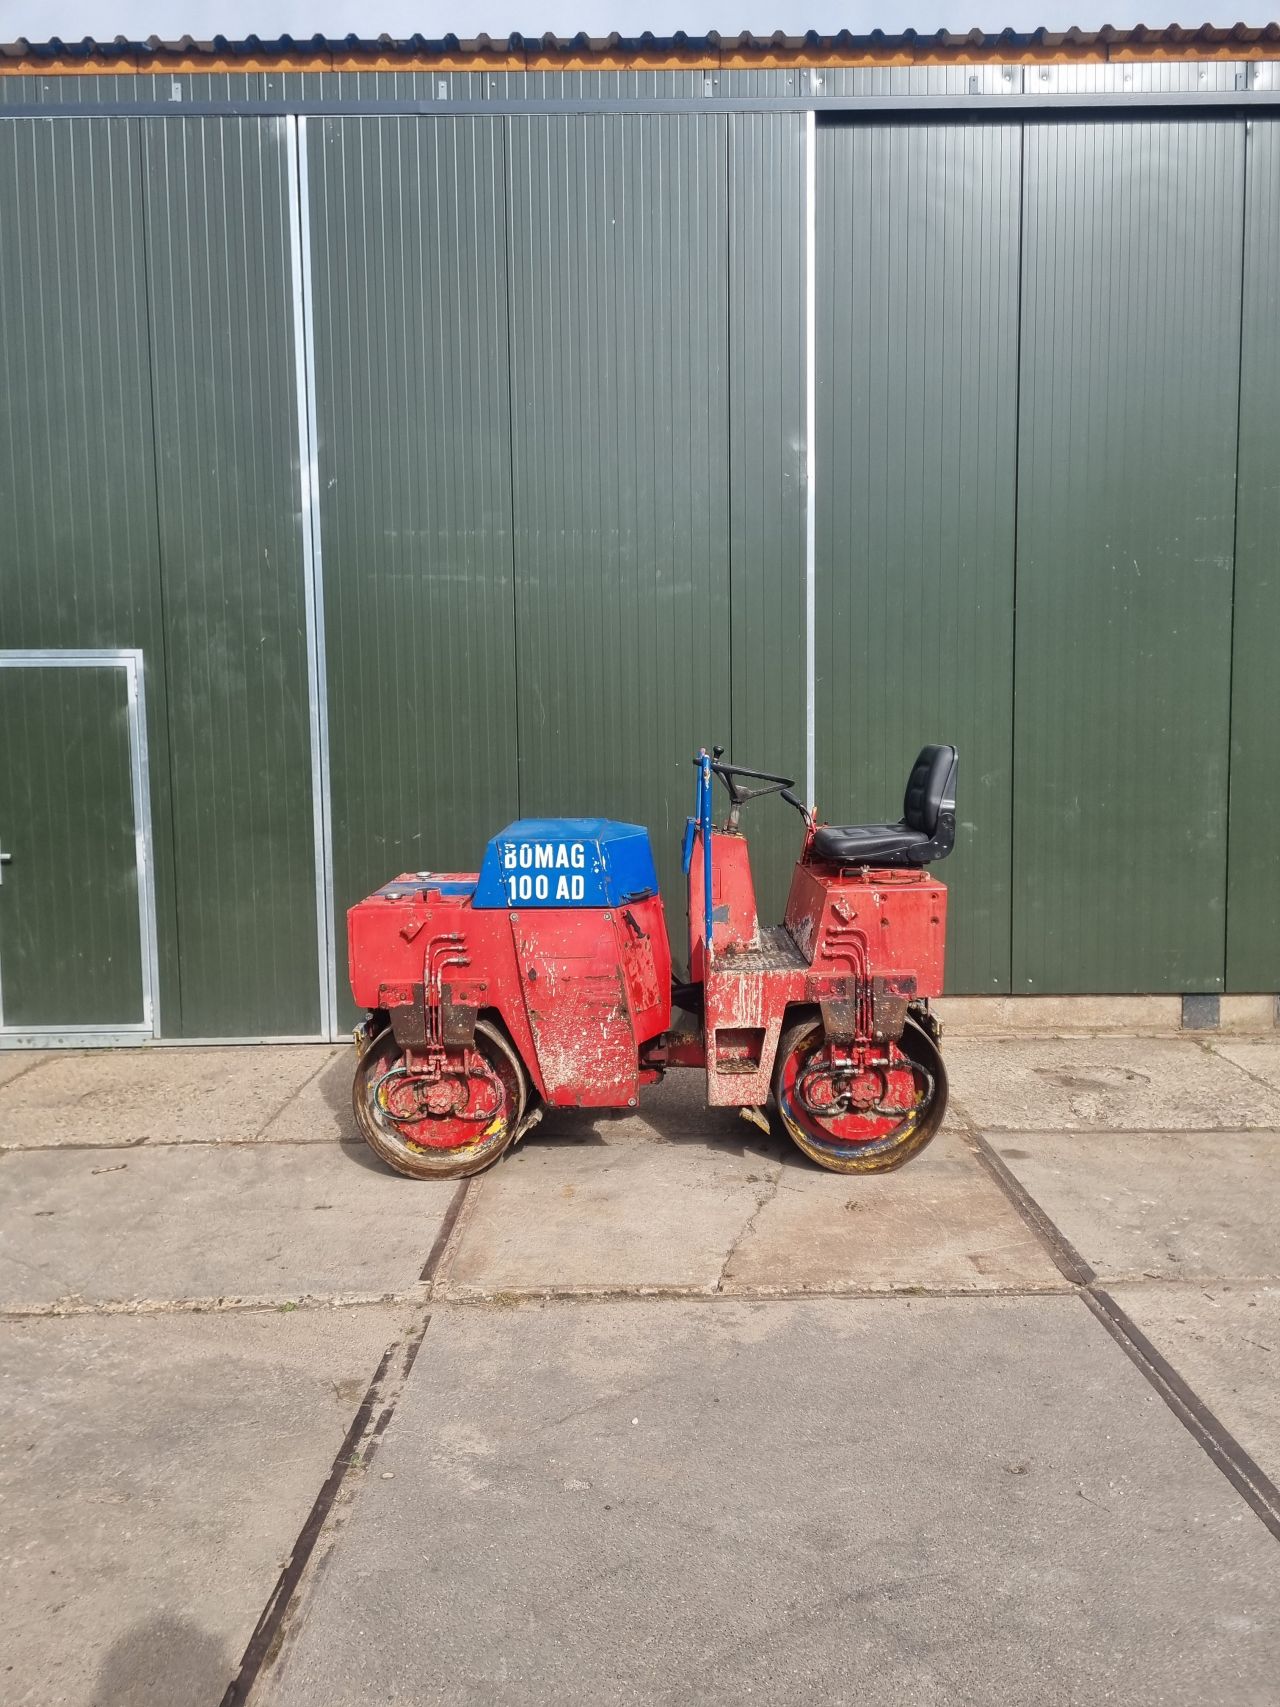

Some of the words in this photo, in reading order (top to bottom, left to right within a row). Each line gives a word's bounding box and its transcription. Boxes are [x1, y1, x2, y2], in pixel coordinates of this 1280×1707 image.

[504, 843, 585, 869] BOMAG
[508, 875, 549, 900] 100
[555, 875, 585, 900] AD
